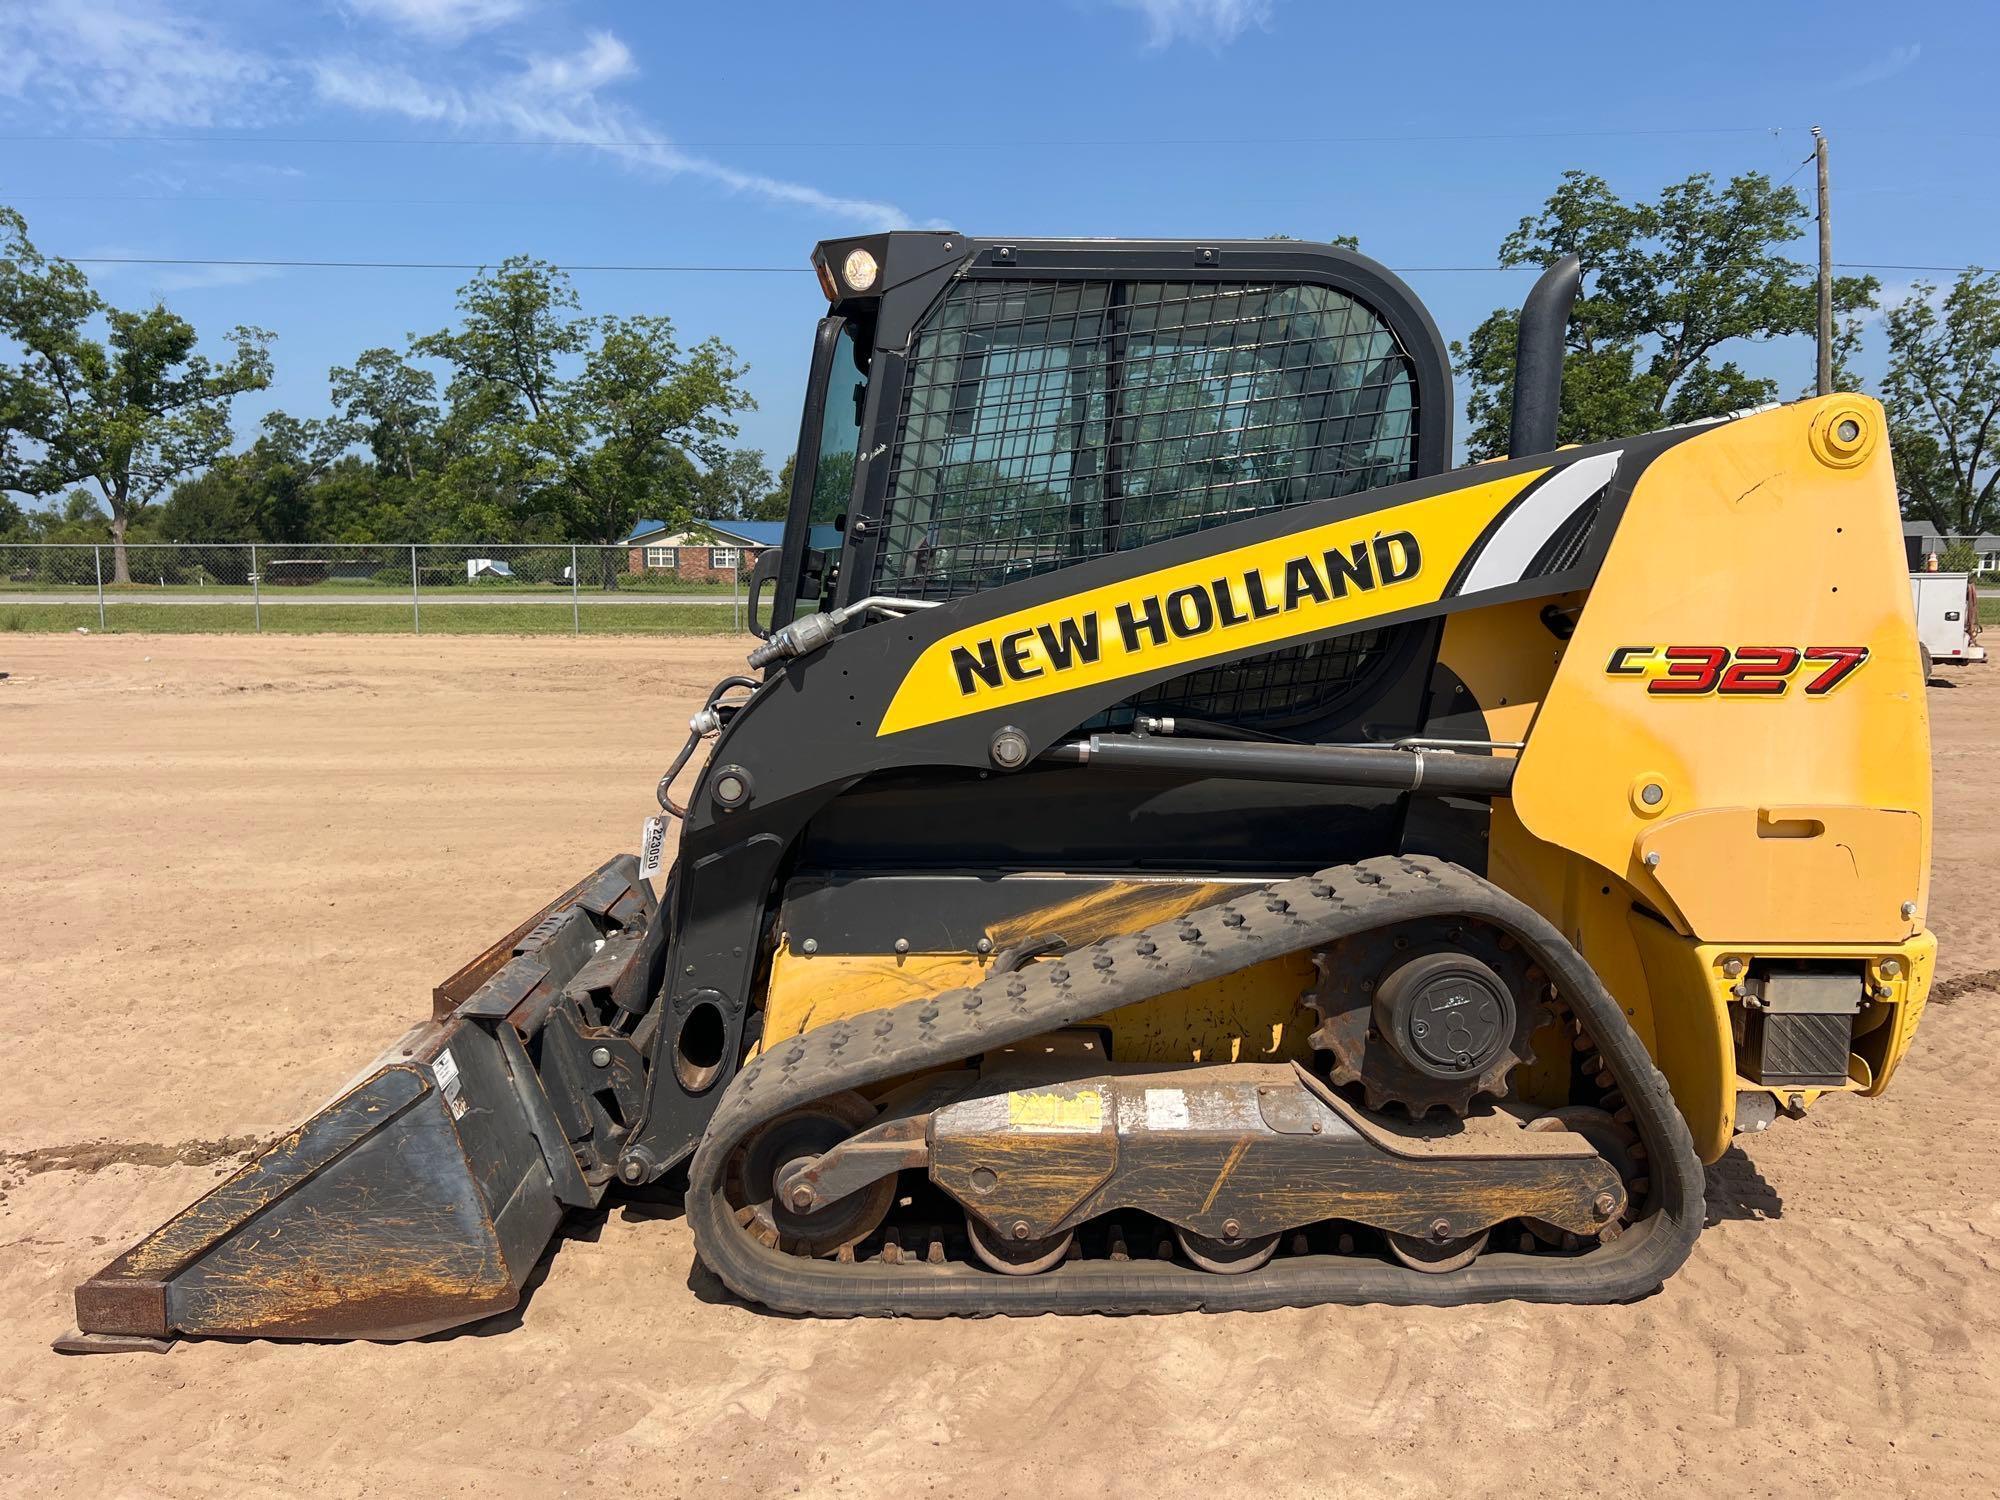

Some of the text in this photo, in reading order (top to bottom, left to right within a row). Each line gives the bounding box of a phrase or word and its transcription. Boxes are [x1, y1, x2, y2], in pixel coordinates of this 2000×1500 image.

[950, 529, 1422, 696] NEW HOLLAND
[648, 828, 663, 869] 223050
